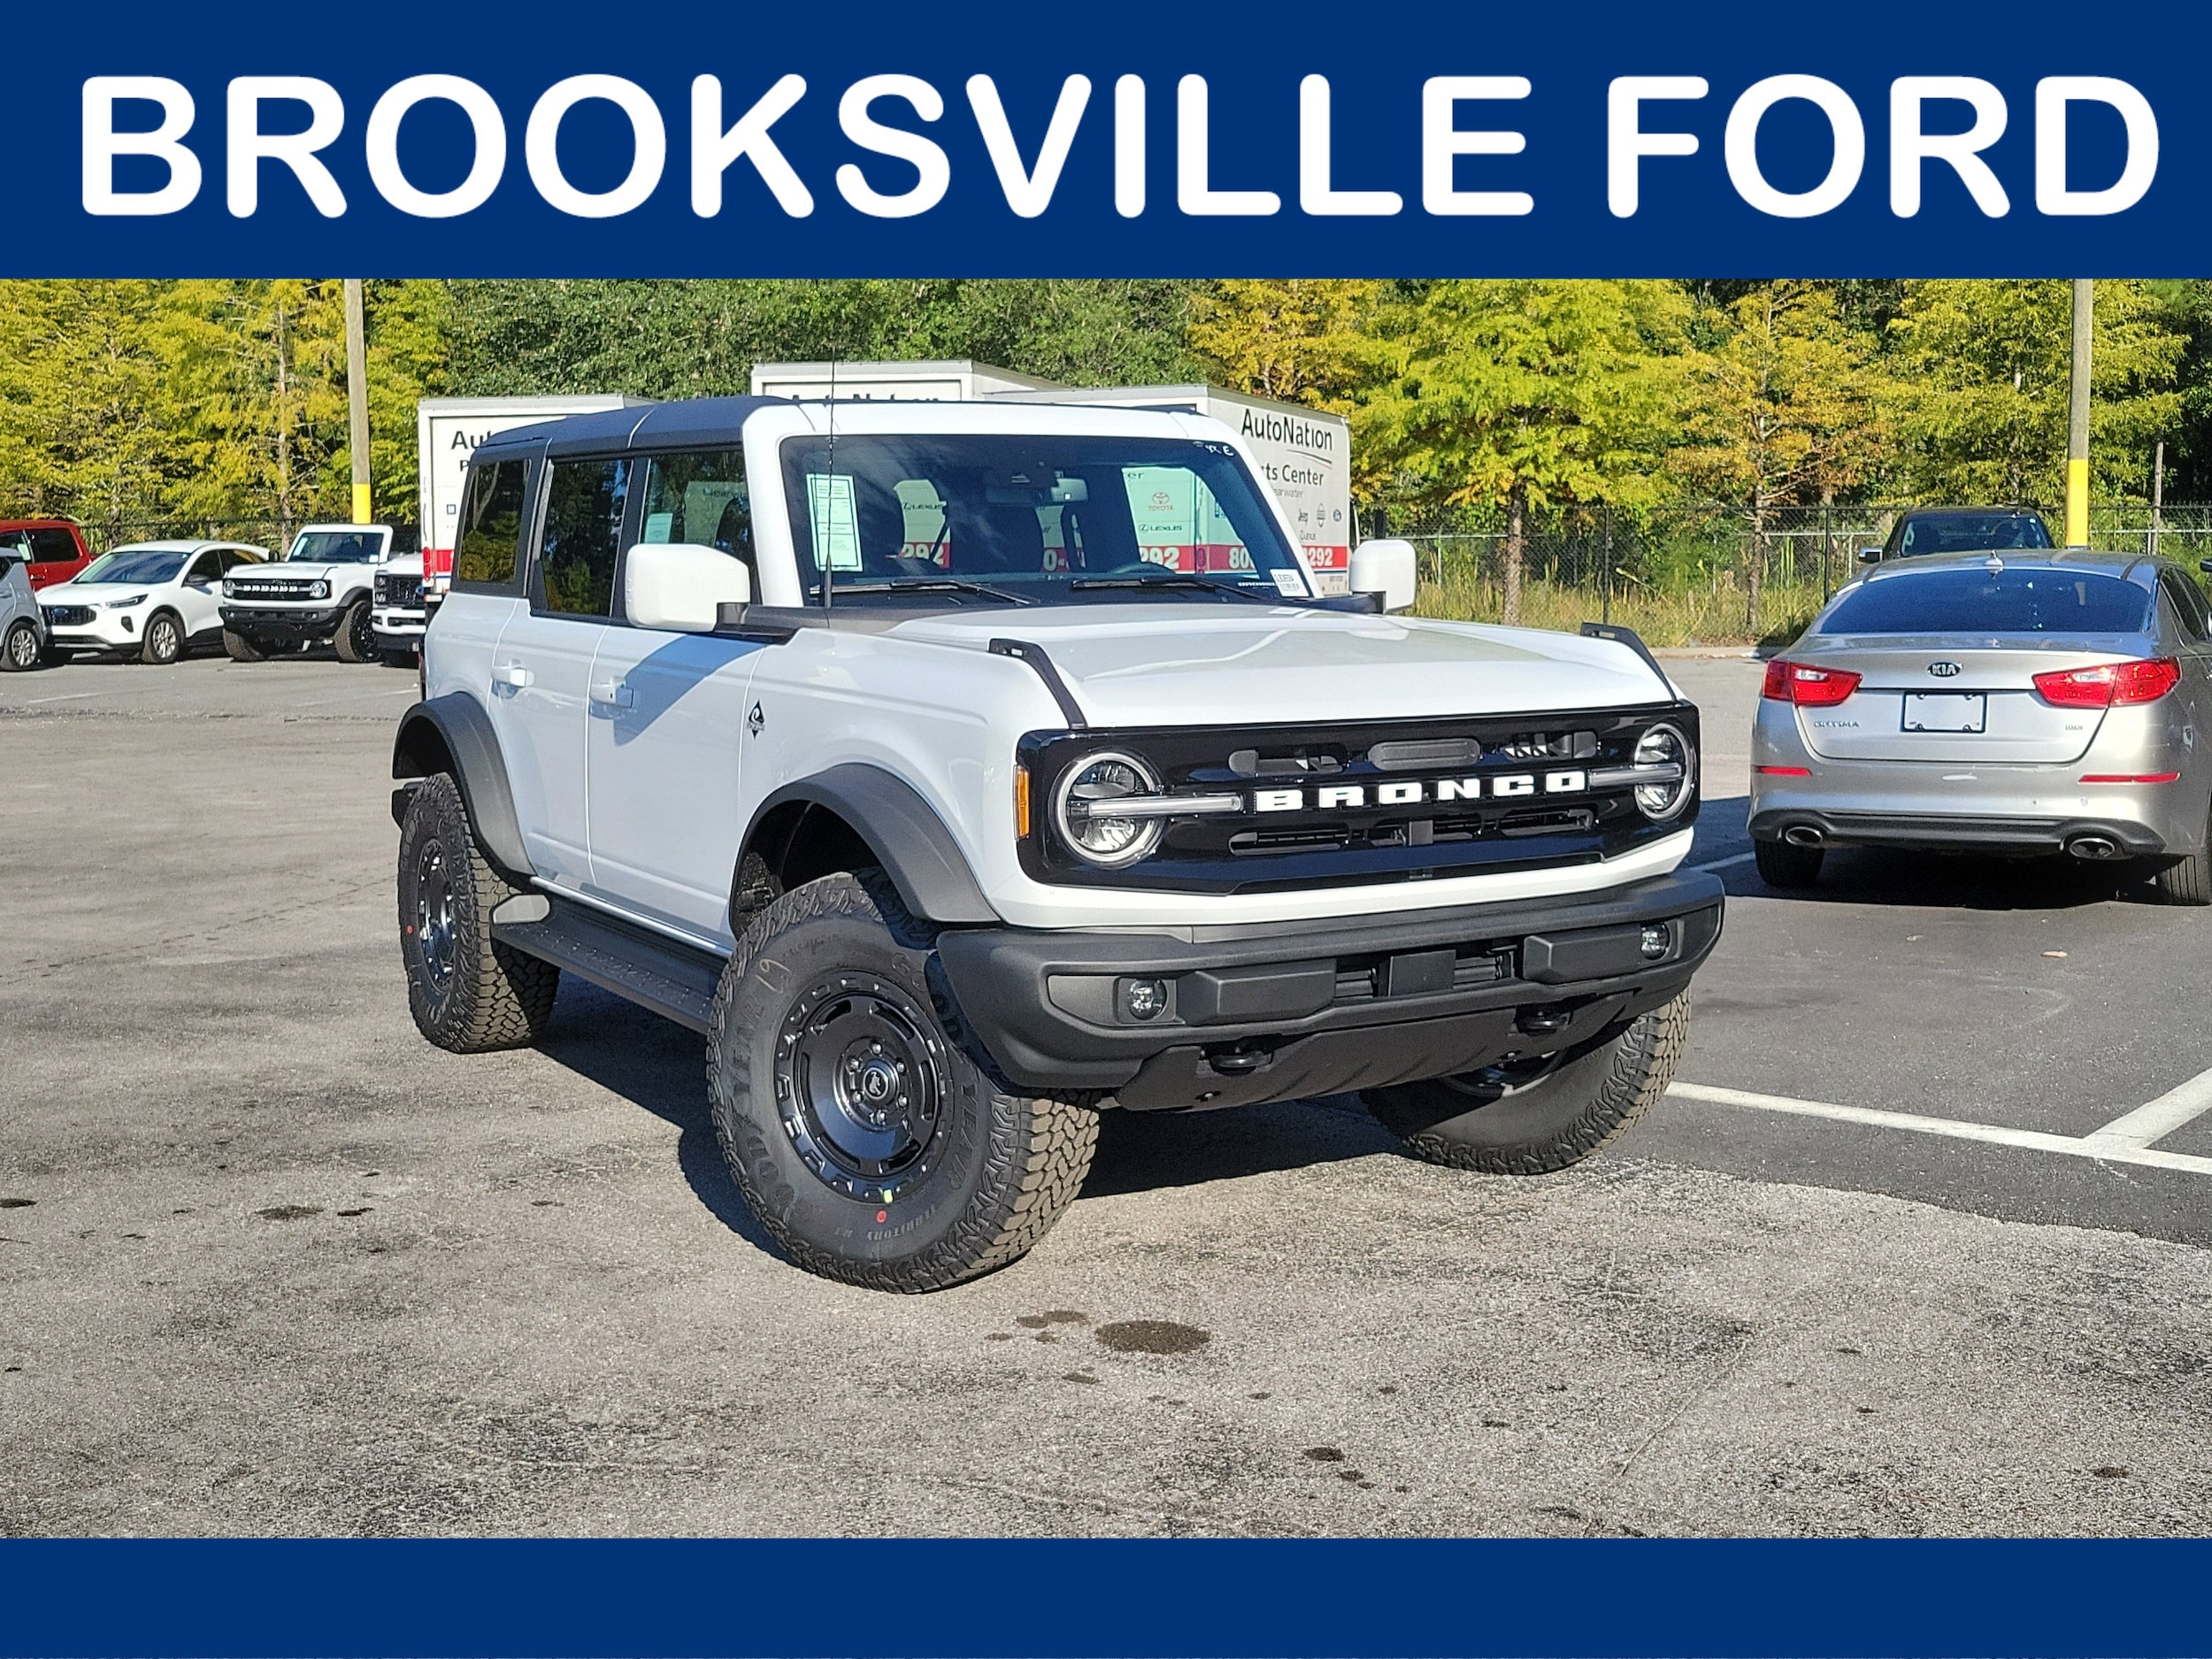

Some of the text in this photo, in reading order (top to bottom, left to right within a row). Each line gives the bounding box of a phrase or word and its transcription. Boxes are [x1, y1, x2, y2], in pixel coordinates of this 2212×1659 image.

[1241, 408, 1333, 451] AutoNation
[1282, 464, 1325, 487] Center
[1305, 548, 1333, 567] 292
[1932, 664, 1956, 675] KIA
[1256, 771, 1586, 812] BRONCO
